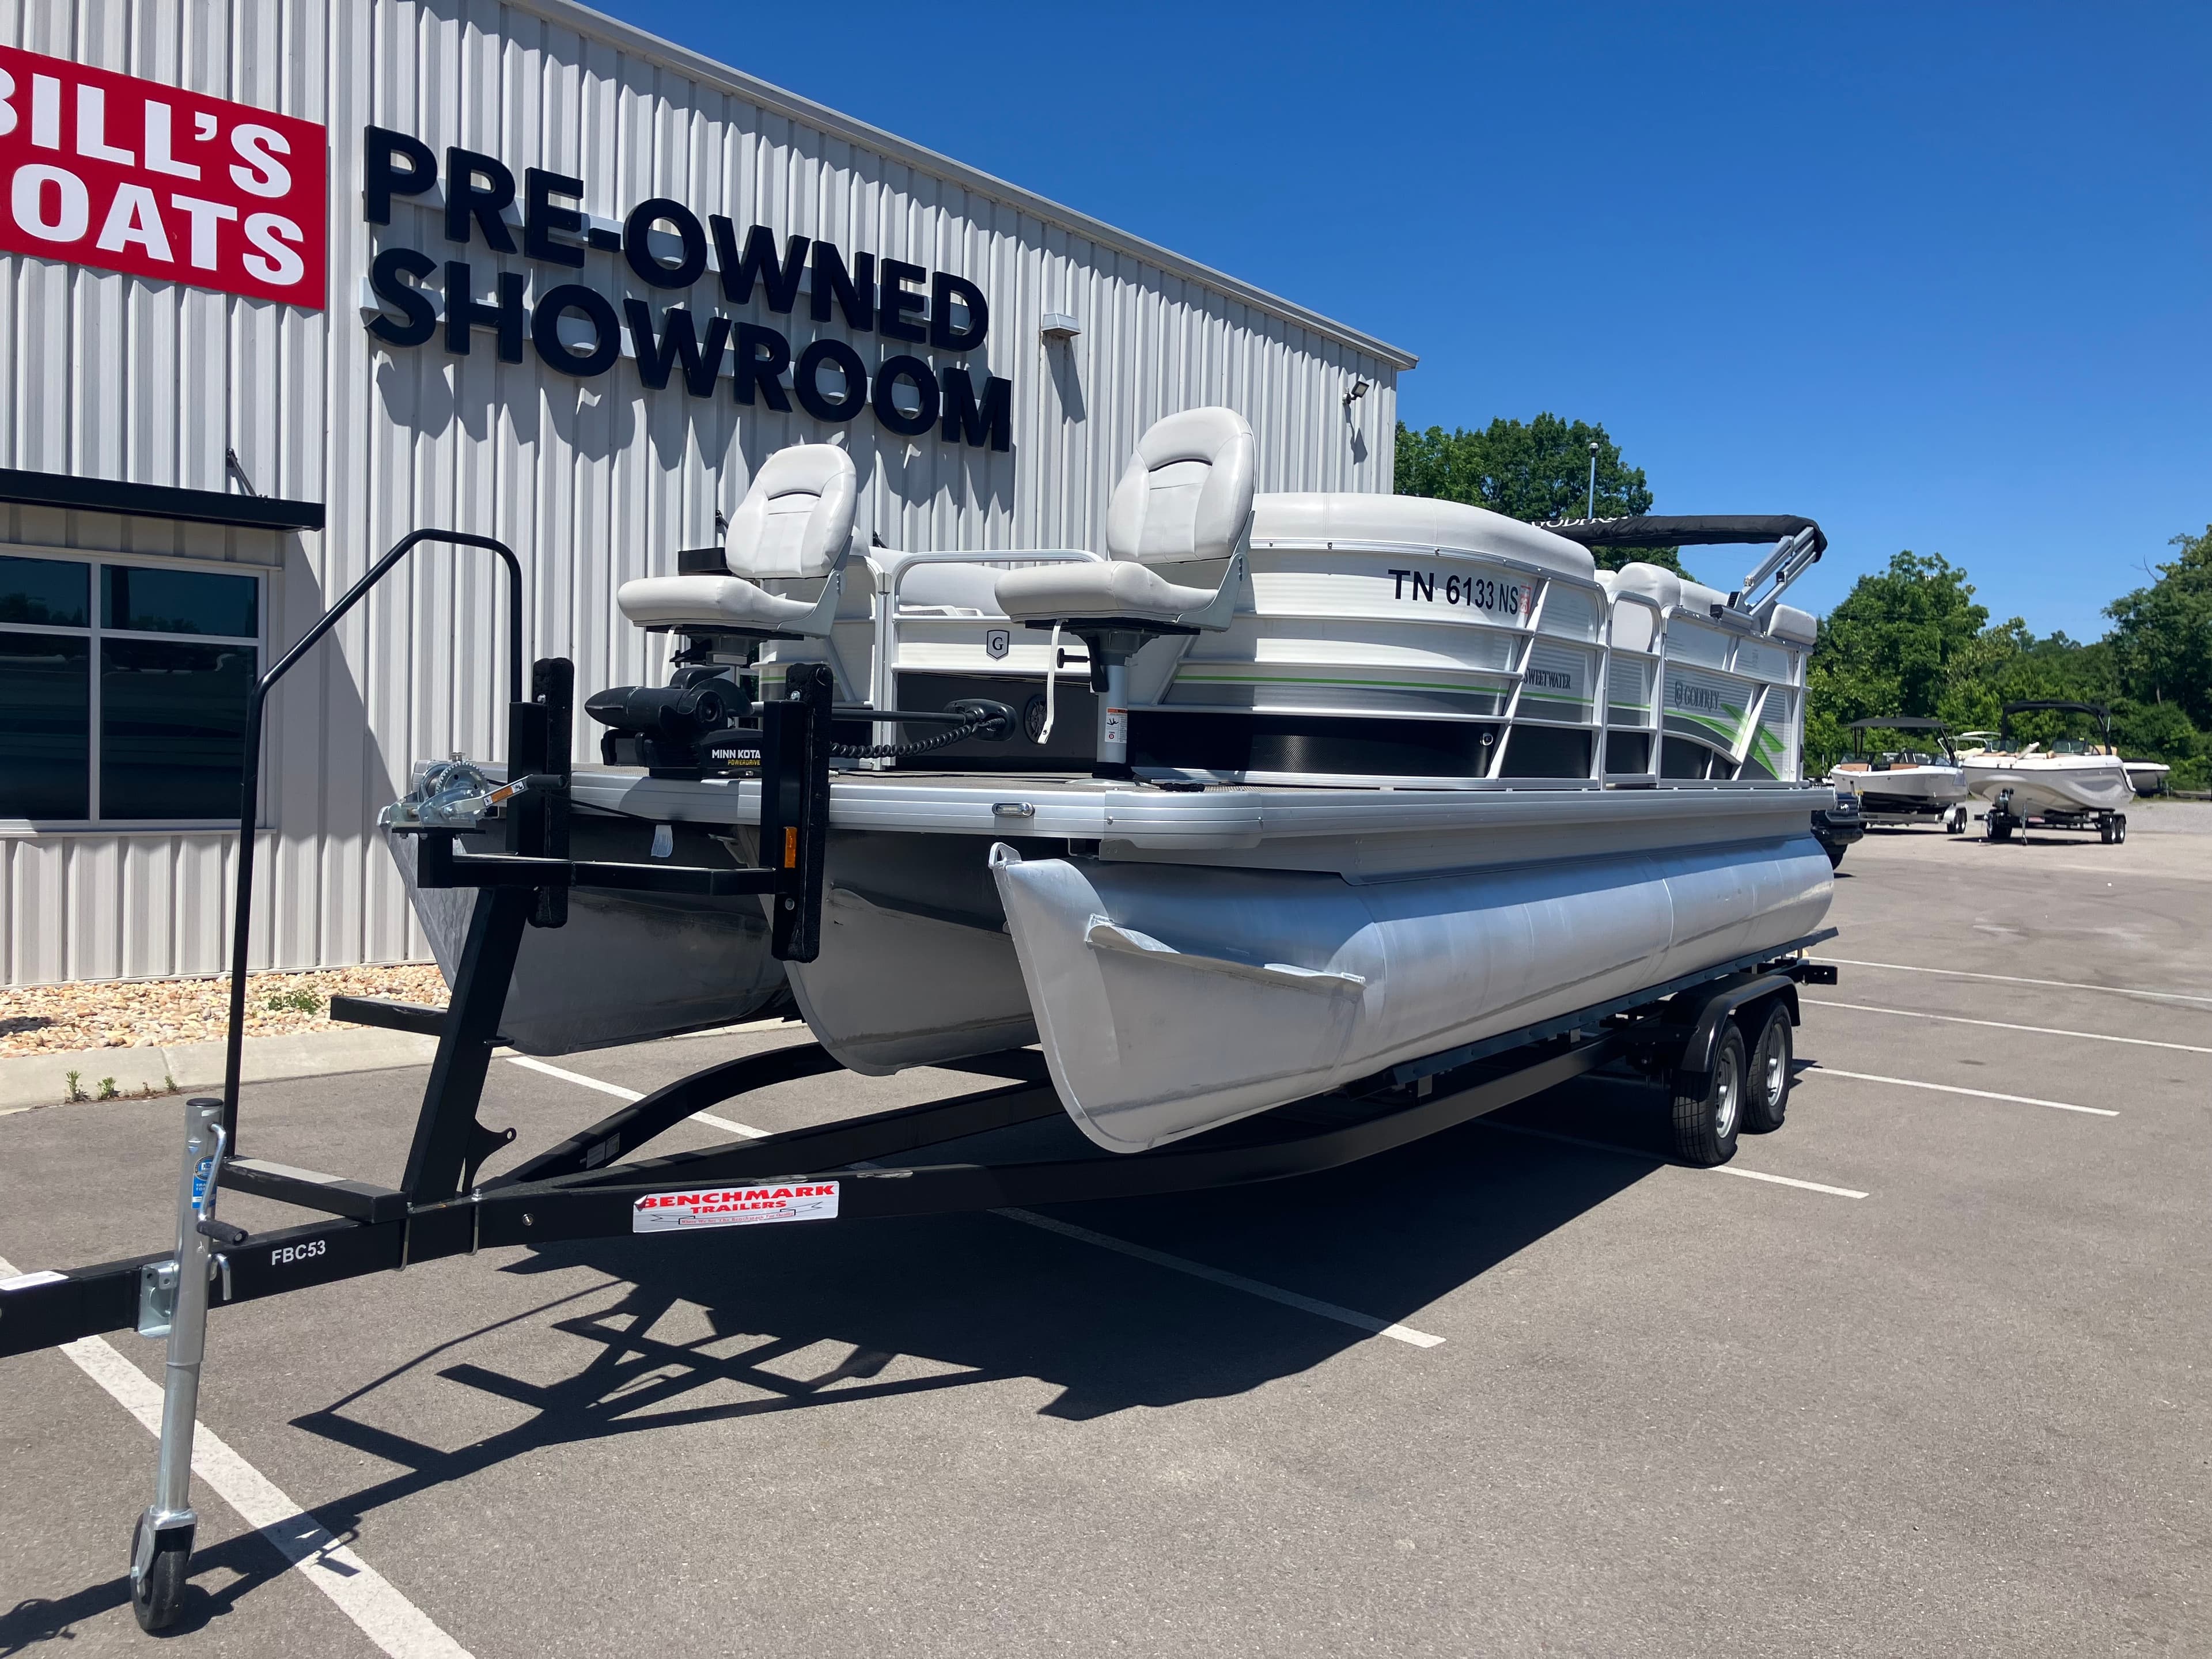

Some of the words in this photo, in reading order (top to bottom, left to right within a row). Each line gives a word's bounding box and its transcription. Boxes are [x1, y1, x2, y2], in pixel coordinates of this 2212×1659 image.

[11, 164, 304, 286] OATS
[363, 124, 989, 353] PRE-OWNED
[364, 247, 1012, 453] SHOWROOM
[1388, 569, 1434, 603] TN
[1446, 575, 1494, 610] 6133
[1499, 583, 1518, 615] NS
[992, 637, 1004, 650] G
[1523, 668, 1571, 690] SWEETWATER
[1684, 685, 1719, 711] GODFREY
[711, 749, 736, 759] MINN
[737, 749, 761, 759] KOTA
[643, 1184, 835, 1209] BENCHMARK
[690, 1200, 787, 1214] TRAILERS
[271, 1240, 326, 1266] FBC53
